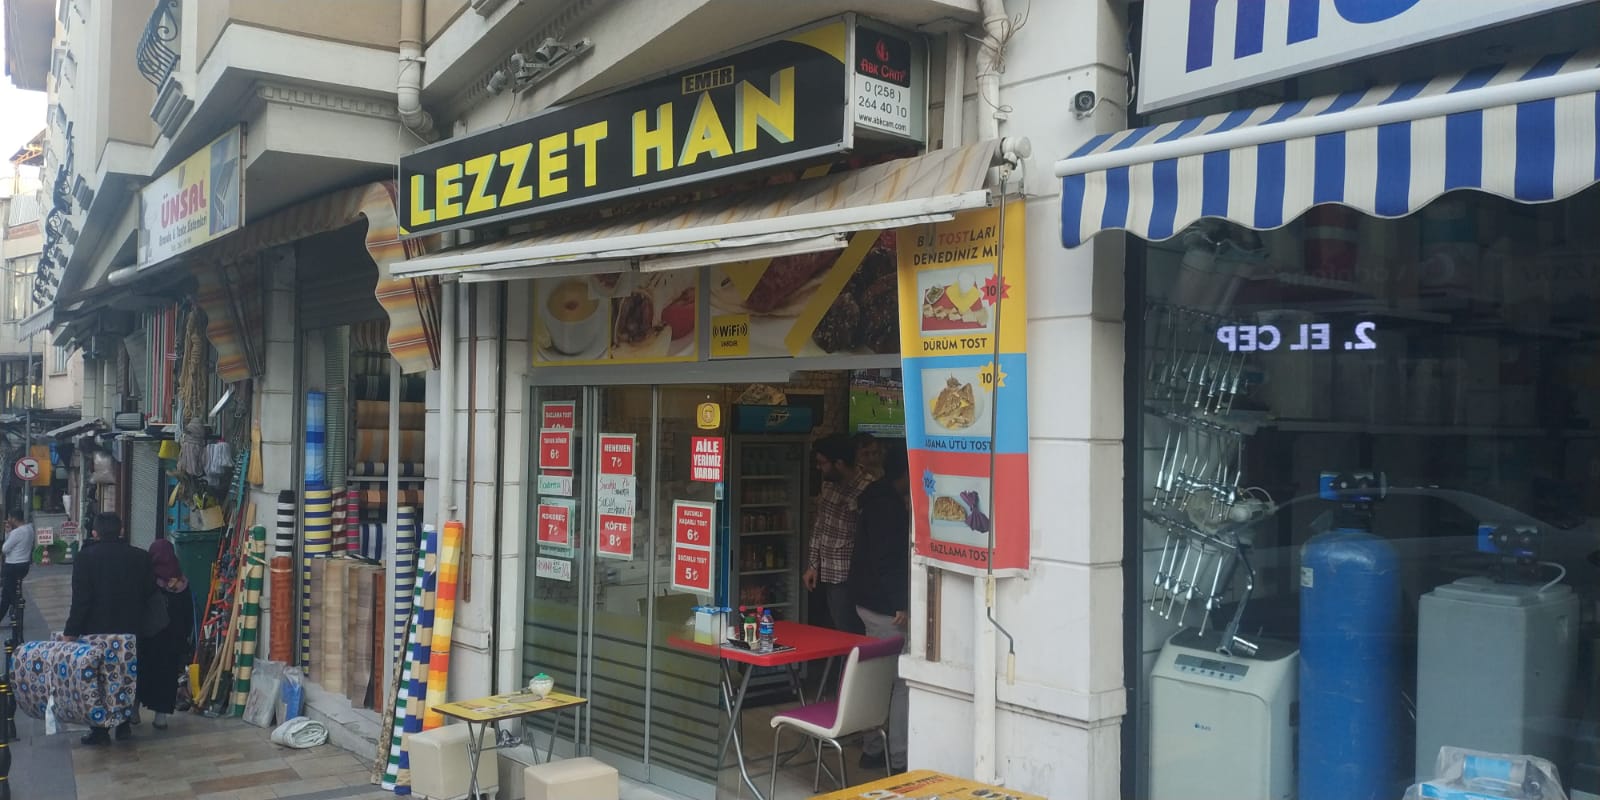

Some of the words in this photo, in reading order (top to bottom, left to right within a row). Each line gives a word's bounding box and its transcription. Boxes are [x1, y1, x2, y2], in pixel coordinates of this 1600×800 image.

[865, 81, 872, 93] 0
[858, 95, 877, 110] 264
[880, 102, 892, 114] 40
[896, 106, 907, 118] 10
[858, 114, 907, 131] www.abkcam.com
[410, 120, 608, 227] LEZZET
[632, 66, 796, 177] HAN
[162, 179, 207, 228] ÜNSAL
[913, 246, 979, 266] DENEDİNİZ
[719, 324, 740, 337] WiFi
[923, 337, 958, 351] DÜRÜM
[960, 337, 988, 350] TOST
[604, 444, 631, 453] MENEMEN
[695, 438, 719, 453] AİLE
[948, 436, 967, 450] ÜTÜ
[693, 453, 721, 467] YERİMİZ
[694, 467, 720, 481] VARDIR
[604, 520, 628, 532] KÖFTE
[930, 542, 967, 558] BAZLAMA
